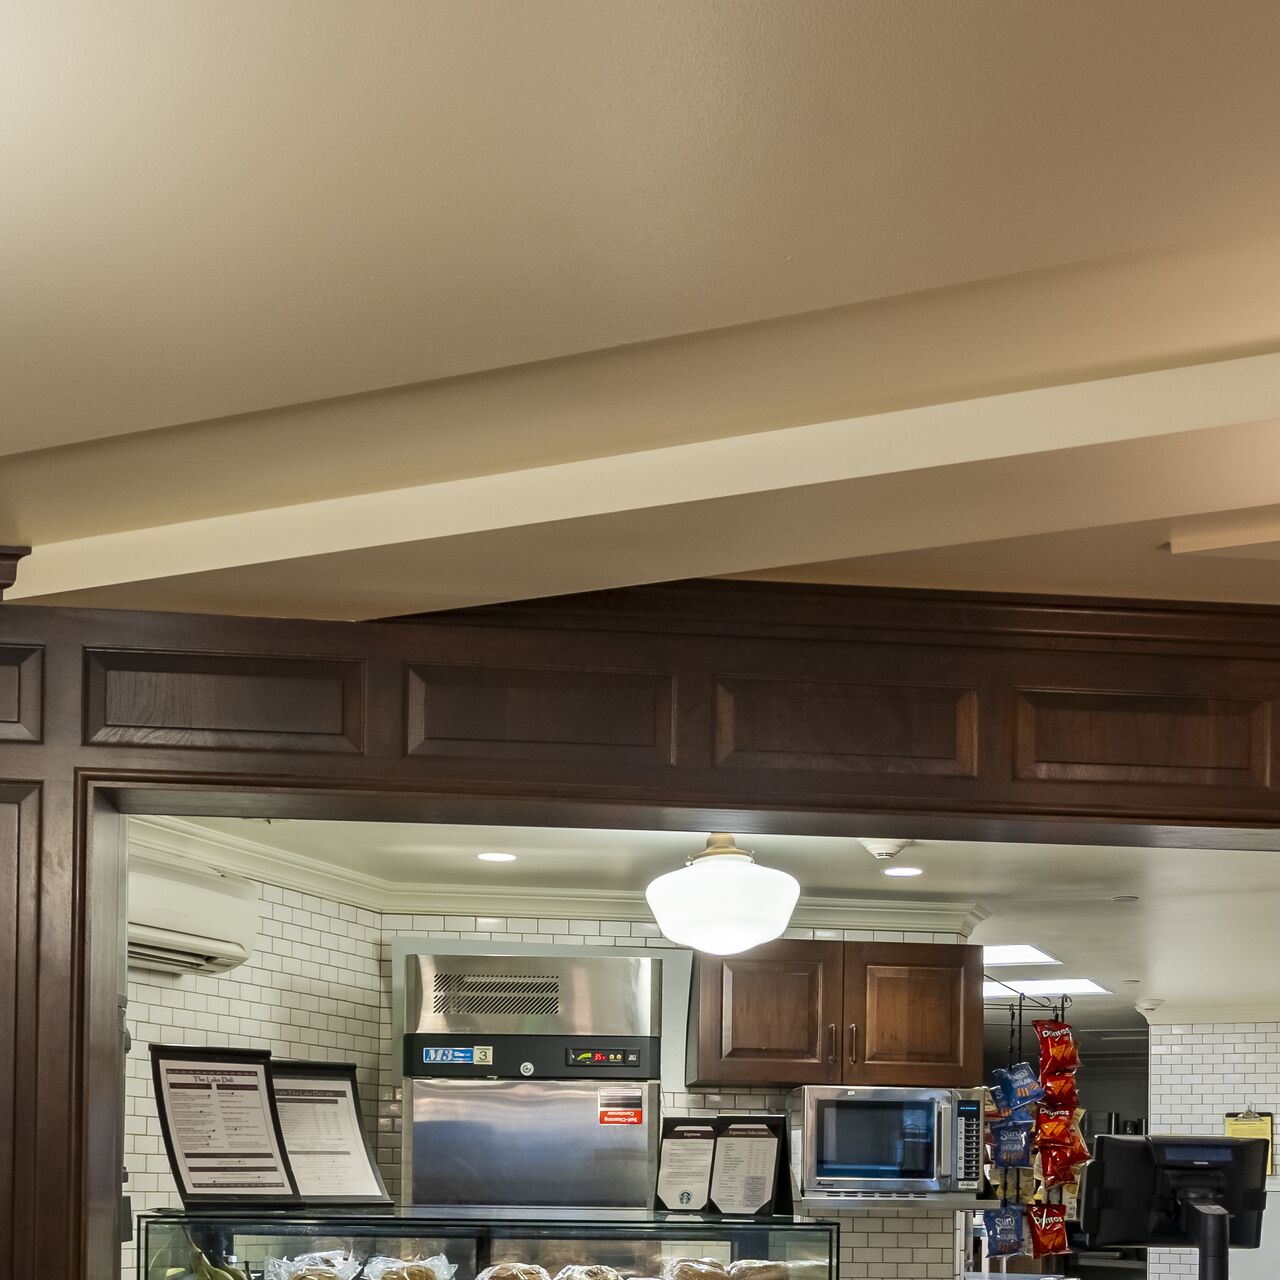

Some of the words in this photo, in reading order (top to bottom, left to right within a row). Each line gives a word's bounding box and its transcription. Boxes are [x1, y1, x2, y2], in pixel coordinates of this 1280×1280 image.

[1042, 1028, 1071, 1038] Doritos
[426, 1049, 453, 1061] M3
[479, 1051, 488, 1060] 3
[1040, 1107, 1070, 1117] Doritos
[1034, 1216, 1063, 1226] Doritos
